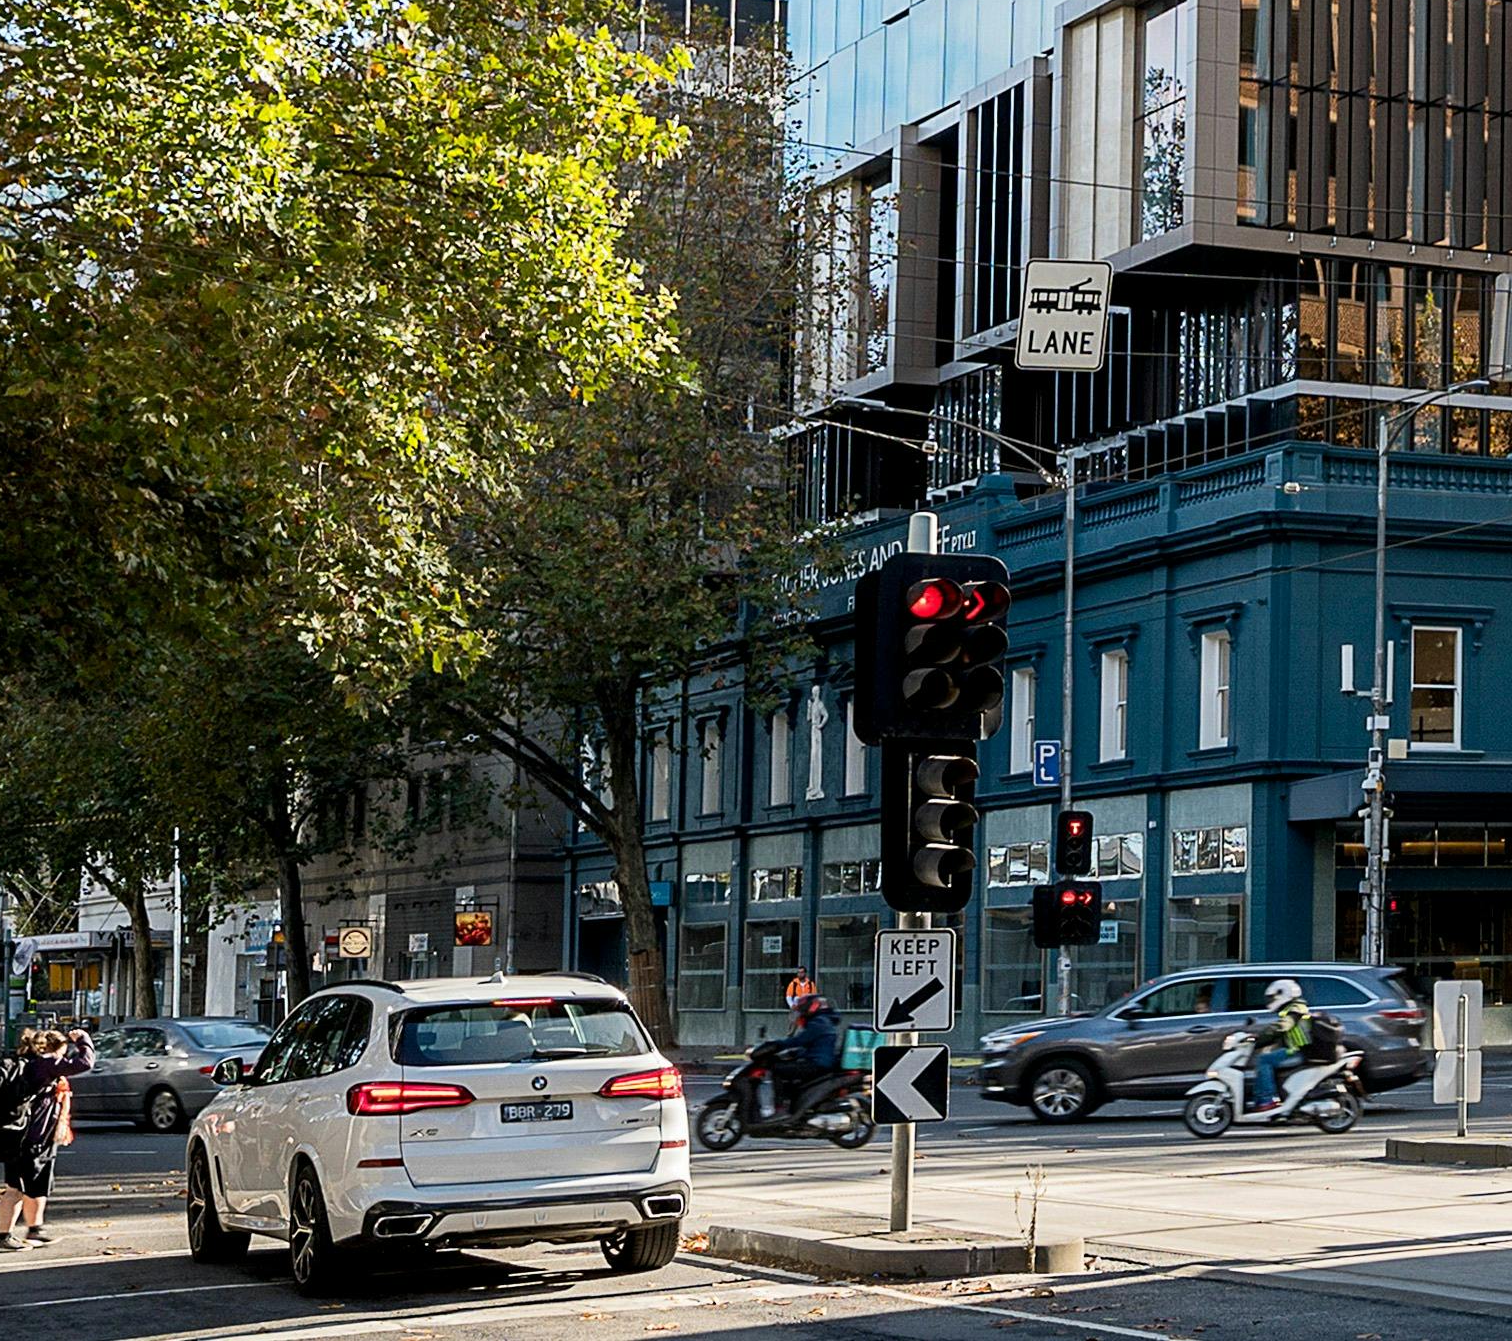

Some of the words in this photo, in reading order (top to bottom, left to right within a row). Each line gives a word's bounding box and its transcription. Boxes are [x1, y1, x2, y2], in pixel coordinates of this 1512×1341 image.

[1028, 330, 1094, 355] LANE
[890, 939, 940, 955] KEEP
[891, 960, 937, 975] LEFT
